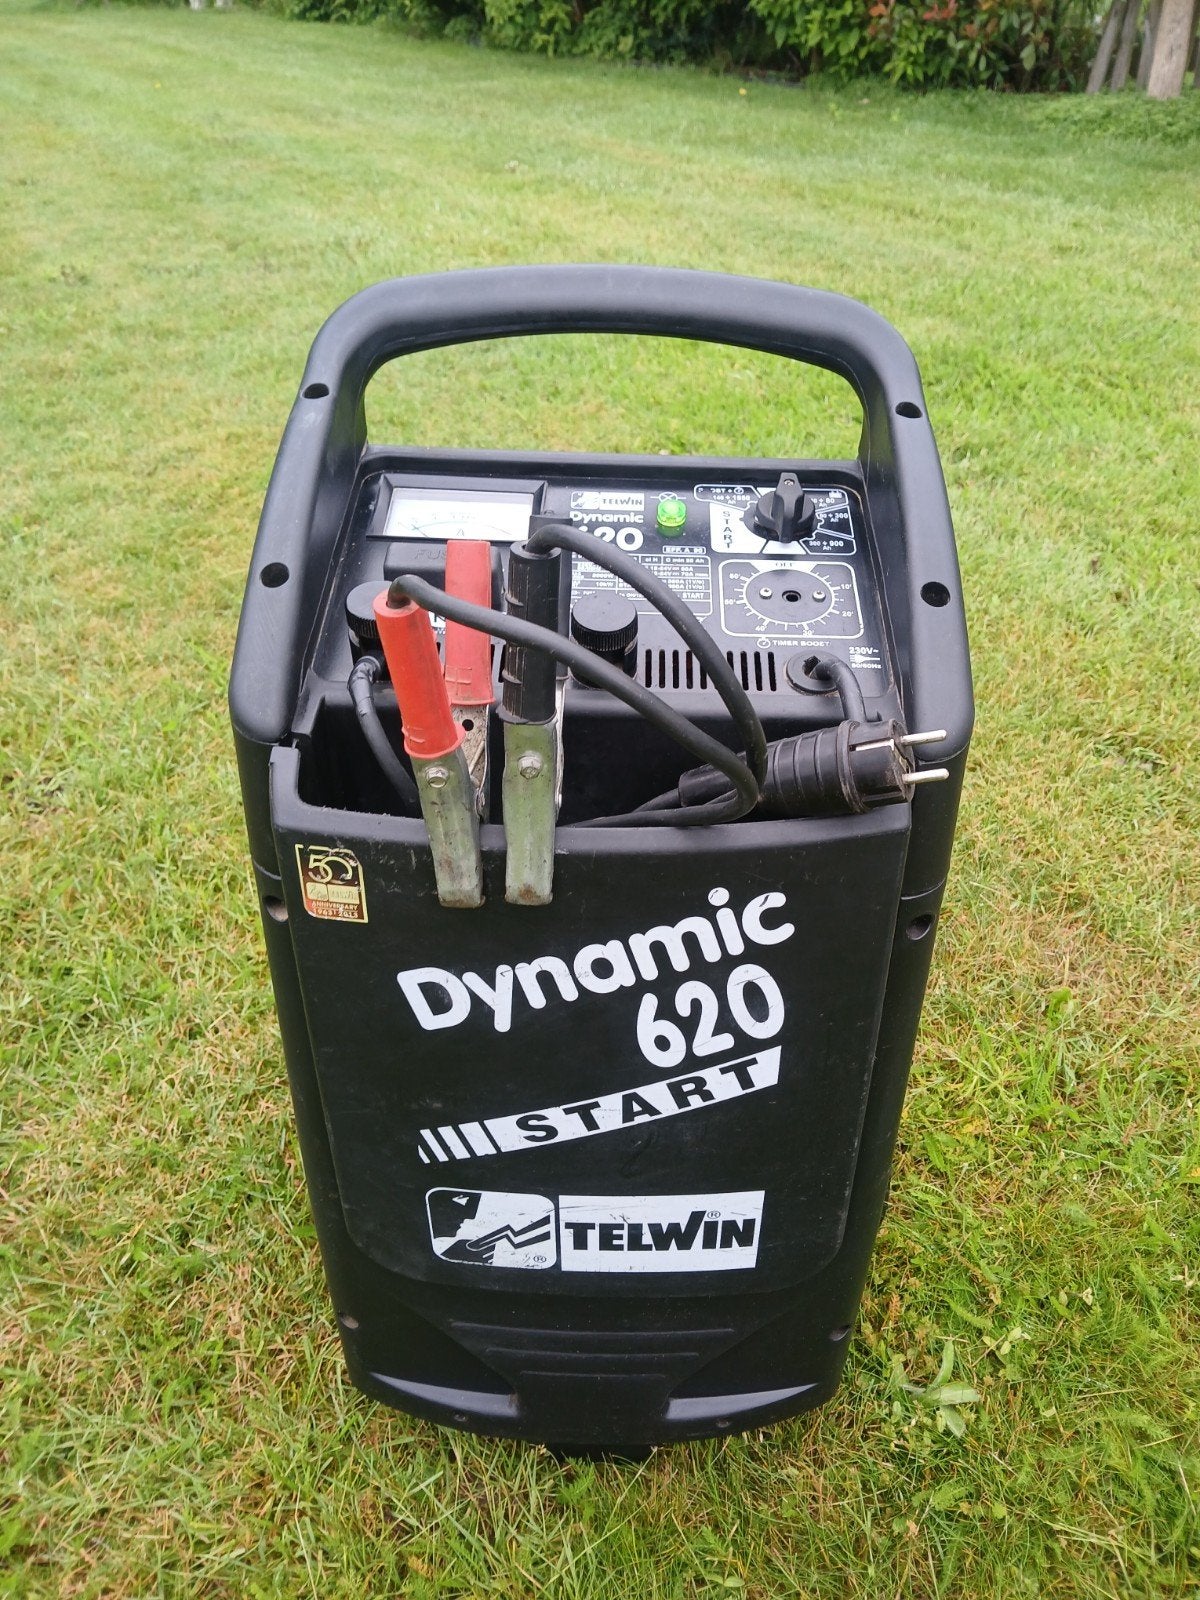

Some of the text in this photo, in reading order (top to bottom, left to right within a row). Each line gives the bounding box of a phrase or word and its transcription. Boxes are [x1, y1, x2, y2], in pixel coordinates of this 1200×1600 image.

[570, 511, 644, 524] Dynamic
[602, 497, 643, 506] TELWIN
[579, 525, 644, 552] 20
[397, 887, 795, 1033] Dynamic
[637, 963, 785, 1068] 620
[515, 1057, 759, 1142] START
[564, 1210, 757, 1252] TELWIN
